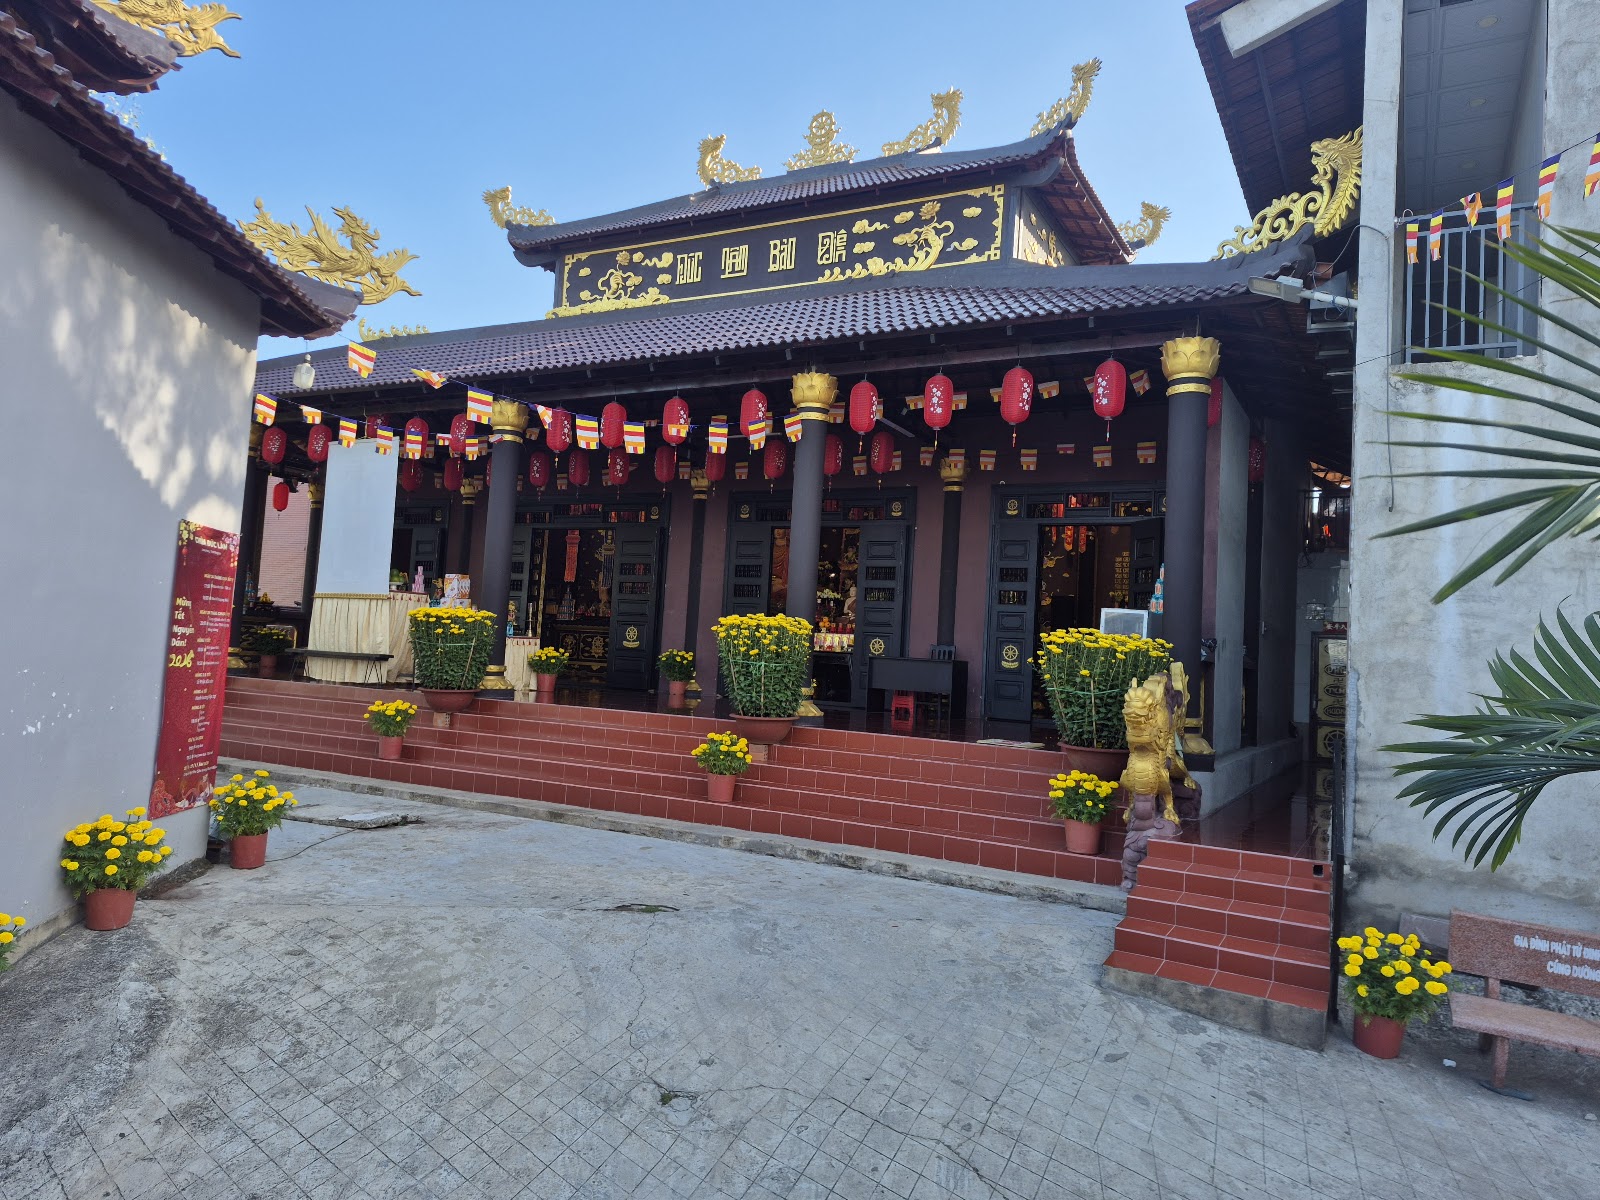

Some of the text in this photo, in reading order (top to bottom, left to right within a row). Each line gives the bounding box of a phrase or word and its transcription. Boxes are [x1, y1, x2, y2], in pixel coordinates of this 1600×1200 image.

[174, 607, 185, 620] Tết
[1513, 934, 1529, 949] GIA
[1546, 959, 1572, 976] CÚNG
